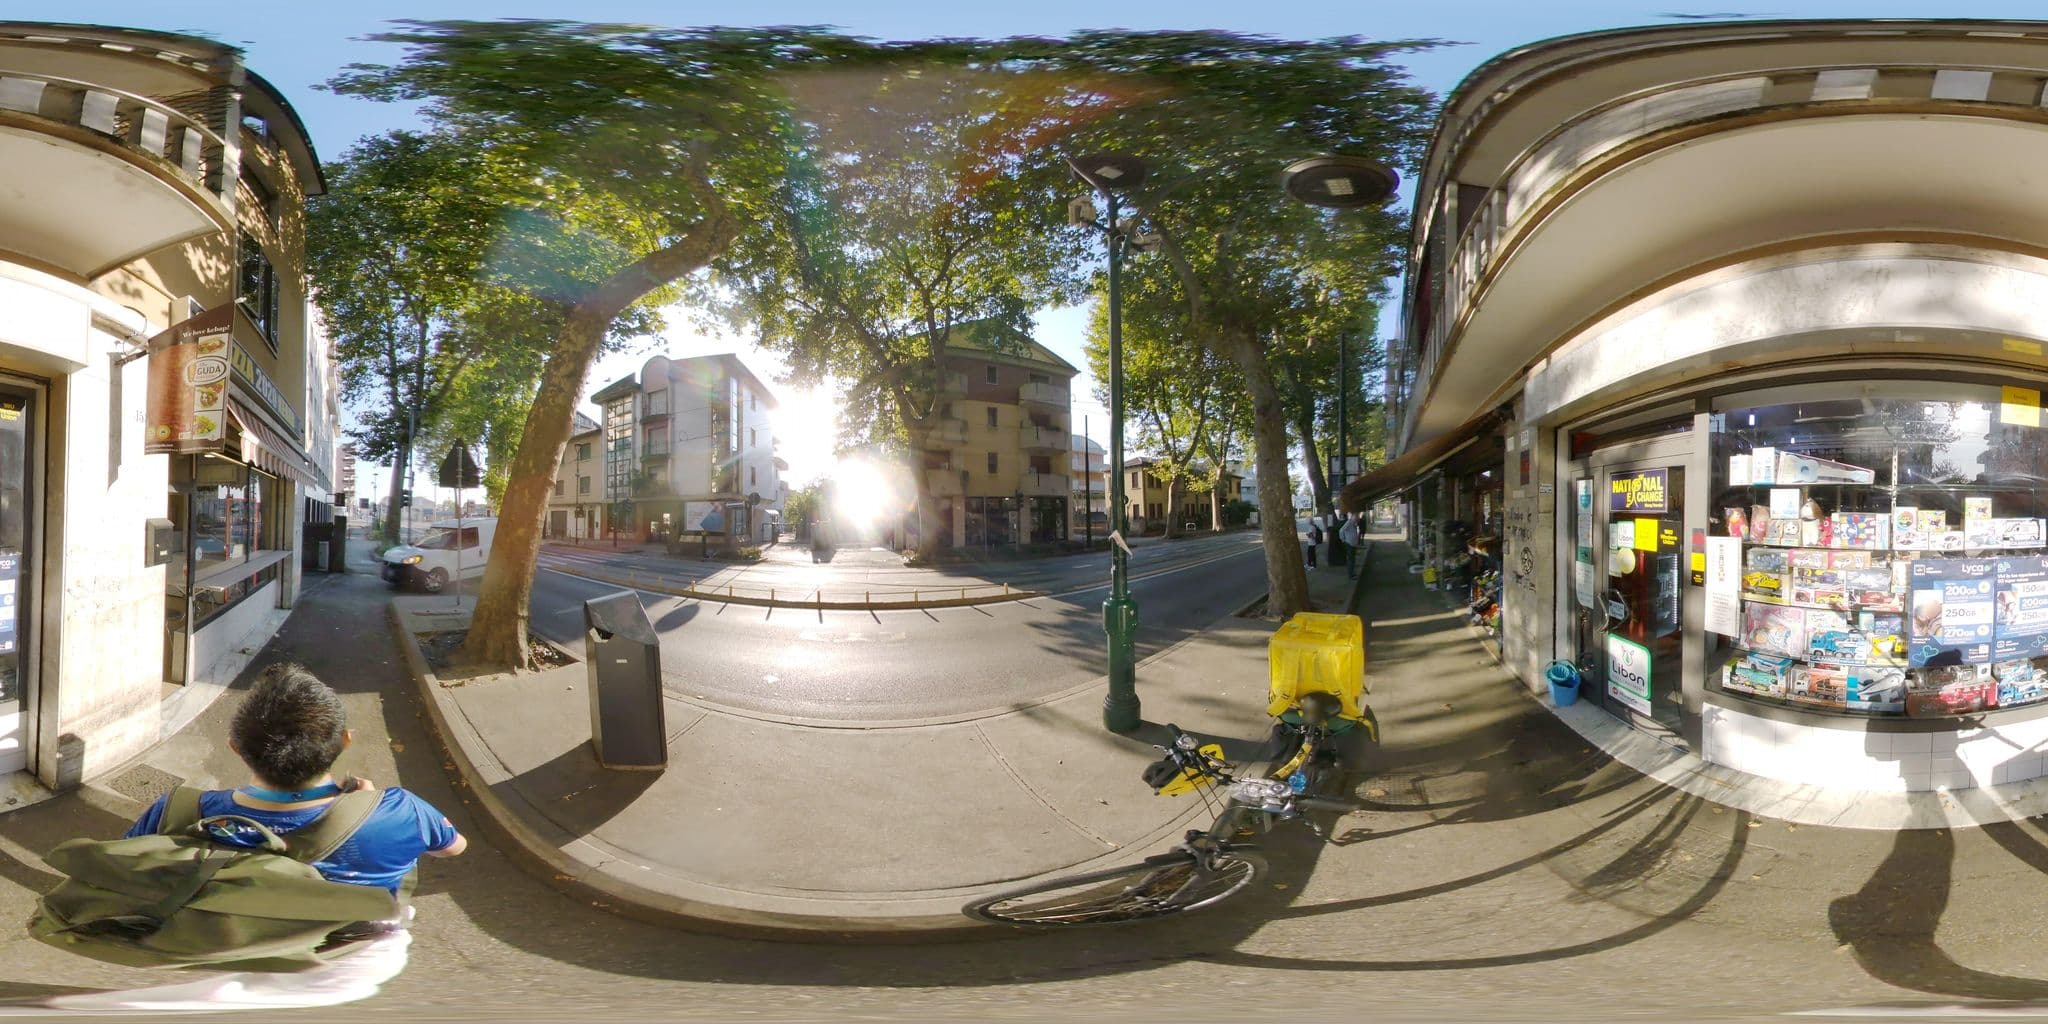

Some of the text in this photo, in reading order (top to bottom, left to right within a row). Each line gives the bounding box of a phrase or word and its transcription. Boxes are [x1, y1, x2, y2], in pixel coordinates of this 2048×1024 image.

[197, 365, 221, 376] GUDA
[1612, 476, 1664, 493] NATIONAL
[1626, 491, 1664, 506] EXCHANGE
[1961, 564, 1984, 574] Lyca
[1945, 608, 1976, 617] 250GB
[1612, 659, 1645, 688] Libon
